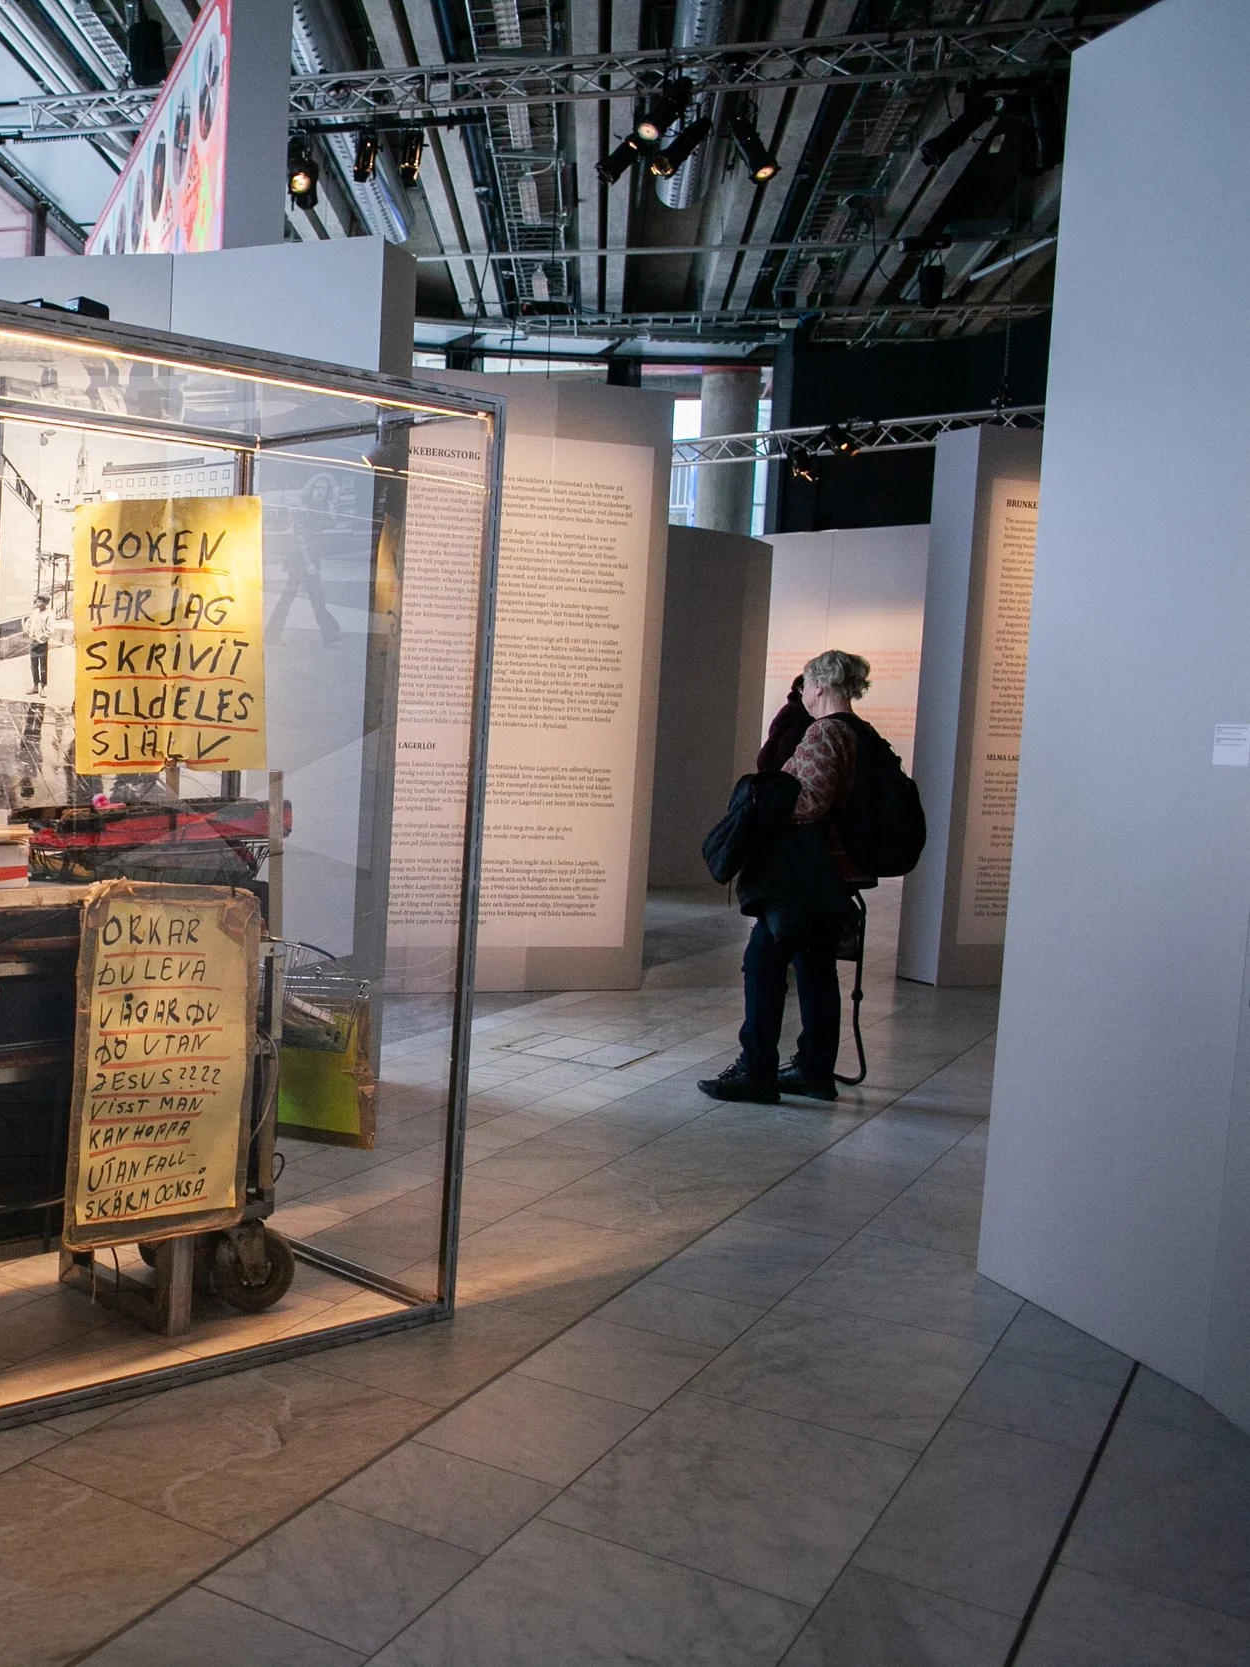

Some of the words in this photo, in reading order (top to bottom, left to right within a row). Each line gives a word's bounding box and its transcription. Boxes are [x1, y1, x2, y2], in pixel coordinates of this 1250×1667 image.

[1006, 499, 1038, 509] BRUNKE
[90, 526, 227, 569] BOKEN
[88, 580, 156, 625] HAR
[85, 633, 250, 677] SKRIVIT
[398, 742, 437, 750] LAGERLÖF
[986, 753, 1007, 761] SELMA
[102, 914, 200, 946] ORKAR
[97, 961, 135, 987] DU
[144, 957, 206, 982] LEVA
[100, 992, 180, 1029] VÅGAR
[186, 999, 220, 1026] DU
[94, 1033, 129, 1067] DÖ
[143, 1033, 211, 1056] UTAN
[91, 1098, 150, 1121] VISST
[160, 1096, 203, 1112] MAN
[89, 1126, 130, 1150] KAN
[133, 1120, 191, 1143] HOPPA
[84, 1188, 150, 1220] SKÄRM
[154, 1166, 207, 1205] OCKSÅ
